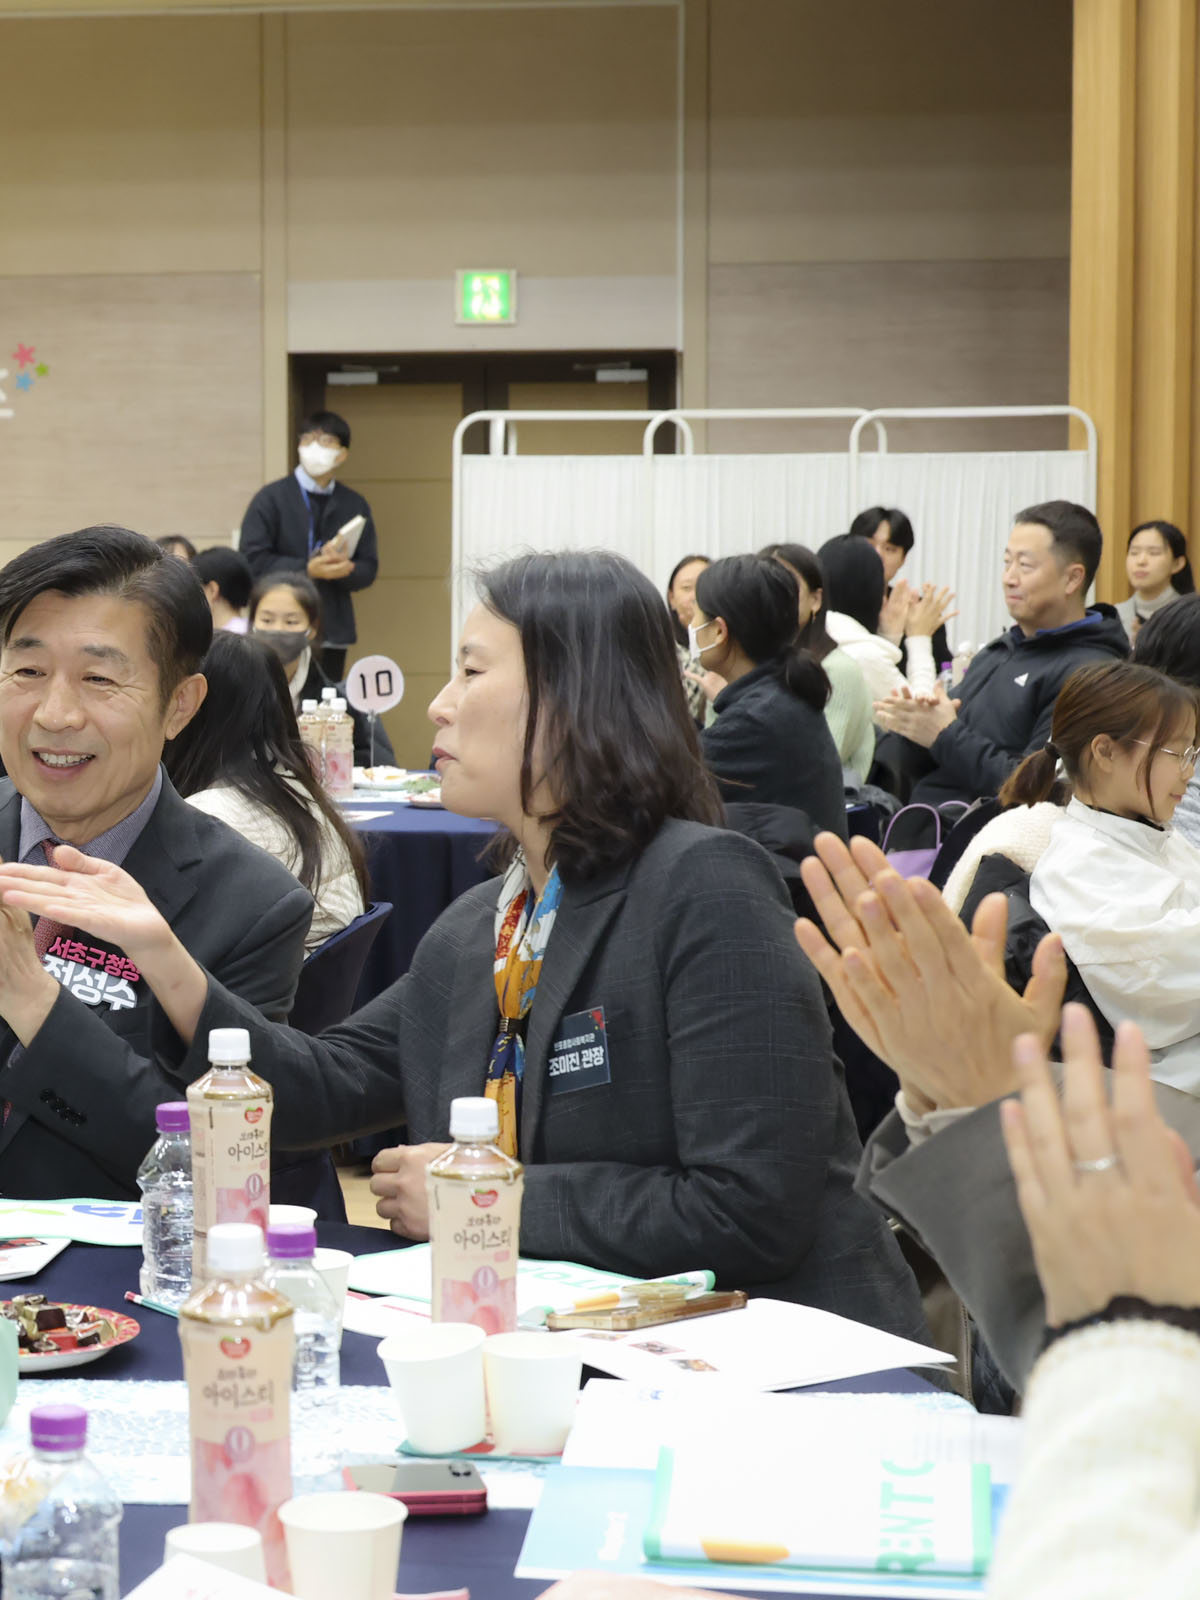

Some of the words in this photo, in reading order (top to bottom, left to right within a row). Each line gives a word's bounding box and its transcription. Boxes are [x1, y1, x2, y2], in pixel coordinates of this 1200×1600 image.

[359, 669, 394, 699] 10
[48, 936, 142, 982] 서초구청장
[548, 1051, 581, 1077] 조미진
[581, 1045, 605, 1069] 관장
[453, 1226, 512, 1250] 아이스티
[202, 1379, 275, 1409] 아이스티
